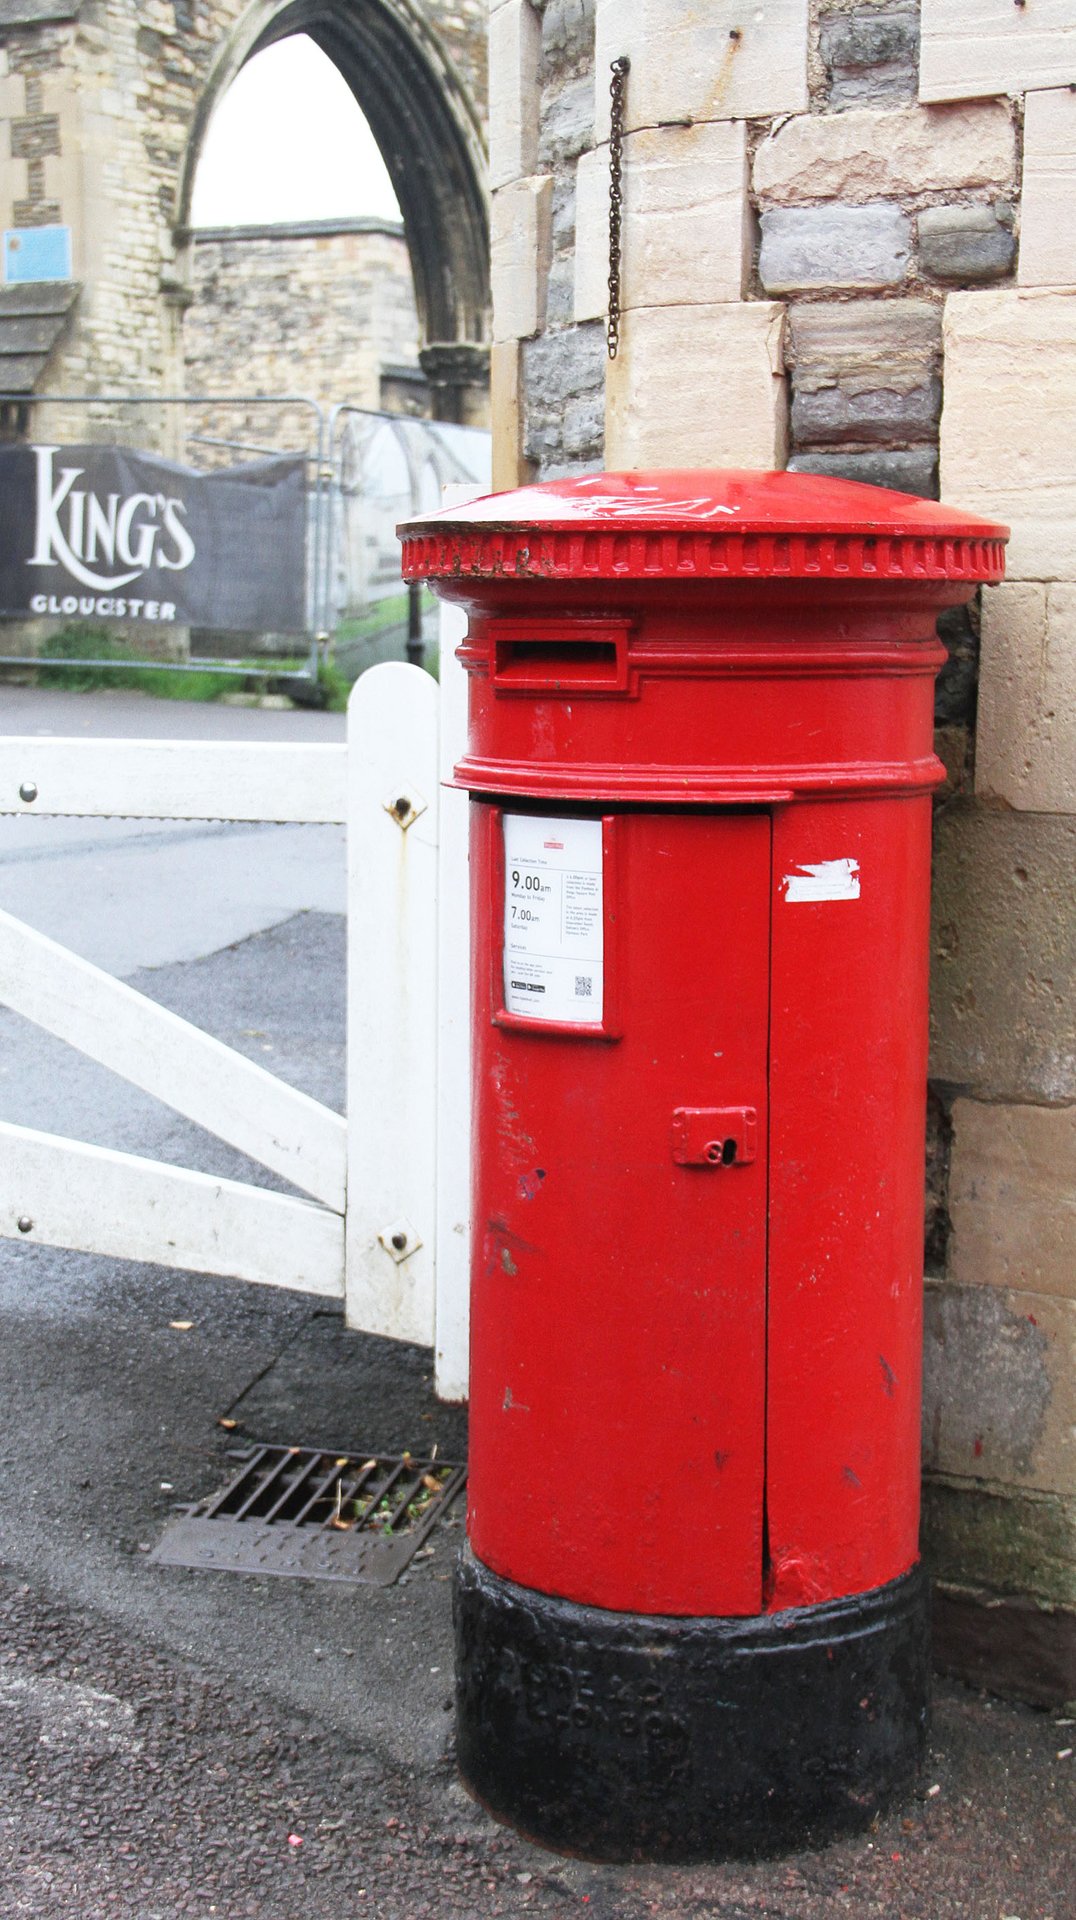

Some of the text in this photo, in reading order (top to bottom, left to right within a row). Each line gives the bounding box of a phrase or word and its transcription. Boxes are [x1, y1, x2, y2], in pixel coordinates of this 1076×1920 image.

[25, 445, 196, 591] KING'S
[512, 871, 551, 892] 9.00am
[511, 892, 526, 900] Monday
[511, 906, 540, 921] 7.00am
